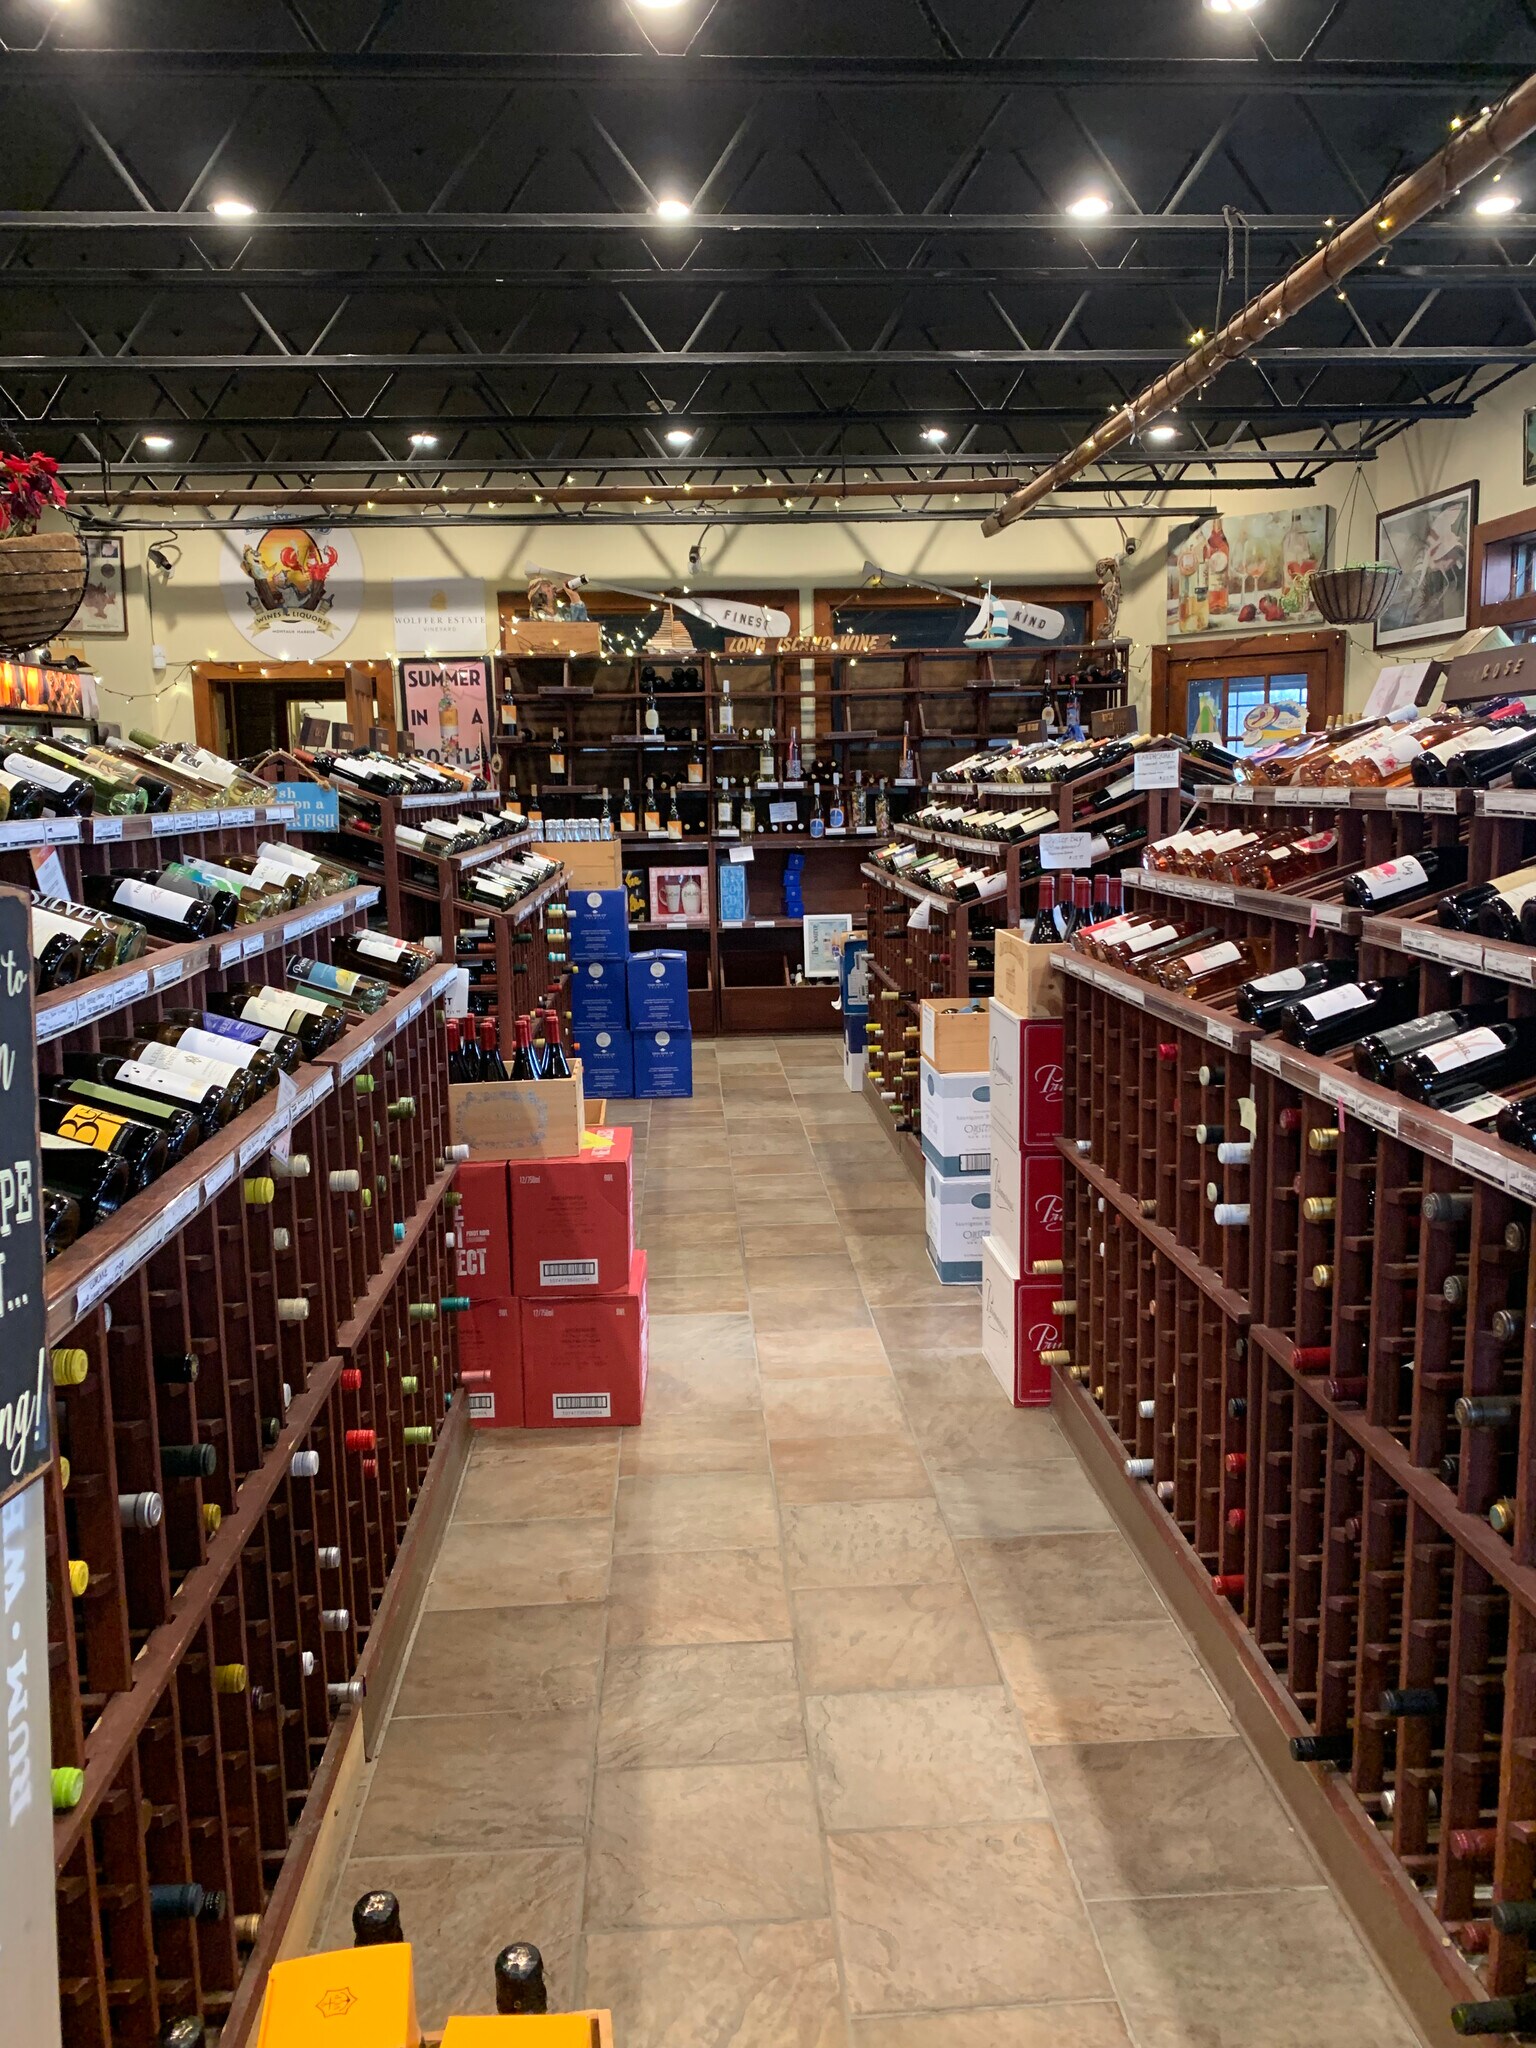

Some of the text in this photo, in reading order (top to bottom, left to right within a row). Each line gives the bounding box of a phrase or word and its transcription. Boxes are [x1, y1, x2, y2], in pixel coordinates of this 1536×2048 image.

[256, 611, 281, 623] WINES
[292, 611, 327, 626] LIQUORS
[447, 616, 485, 625] ESTATE
[723, 609, 771, 631] FINEST
[1013, 610, 1047, 630] KIND
[729, 635, 880, 653] LONG ISLAND WINE
[408, 669, 481, 688] SUMMER
[1480, 658, 1525, 681] ROSE
[411, 708, 484, 726] IN A
[315, 801, 324, 810] a
[304, 813, 335, 828] FISH
[7, 1649, 32, 1828] RUM
